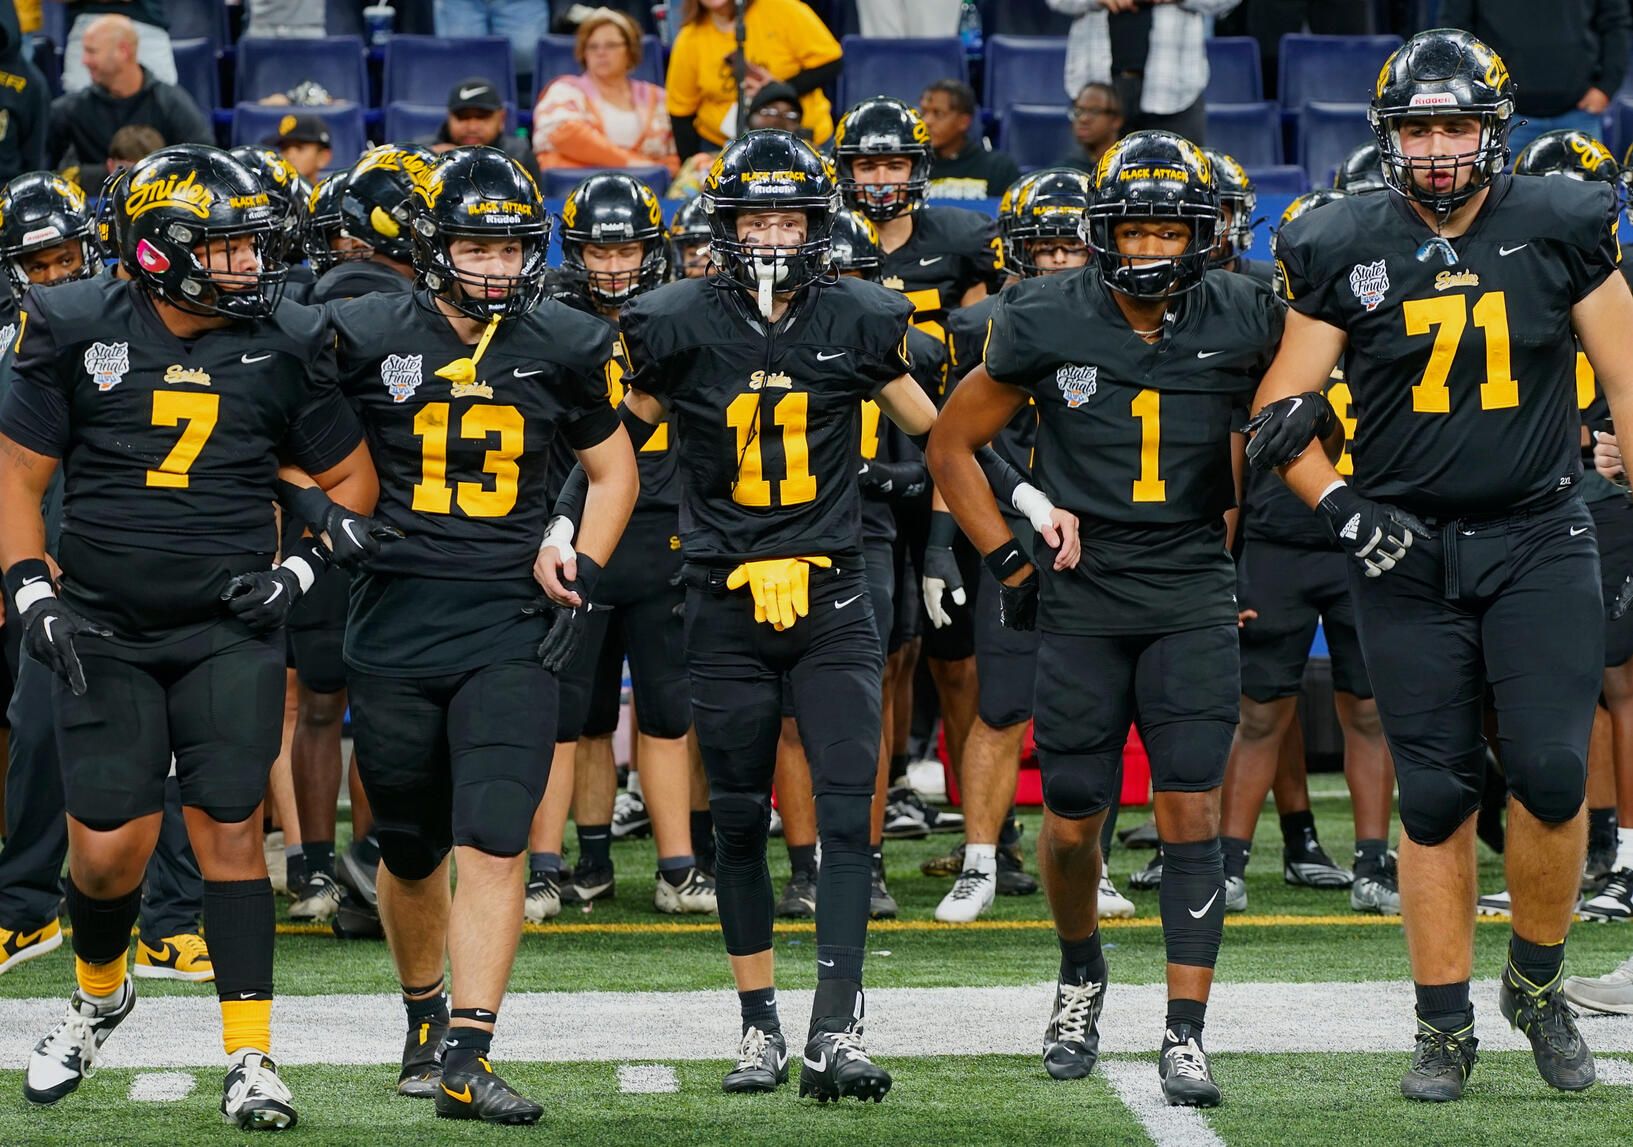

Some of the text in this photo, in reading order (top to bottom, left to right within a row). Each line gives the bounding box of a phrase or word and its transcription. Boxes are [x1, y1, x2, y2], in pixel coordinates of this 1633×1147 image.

[741, 170, 806, 183] BLACK ATTACK
[1120, 168, 1189, 183] BLACK ATTACK
[126, 169, 212, 222] Snider
[229, 196, 255, 208] BLACK
[468, 202, 532, 216] BLACK ATTACK
[1350, 262, 1386, 280] State
[1351, 275, 1389, 297] Finals
[87, 343, 127, 360] State
[1403, 290, 1520, 414] 71
[86, 358, 128, 375] Finals
[382, 356, 421, 372] State
[1058, 363, 1096, 380] State
[383, 370, 421, 388] Finals
[1058, 376, 1095, 395] Finals
[146, 390, 219, 488] 7
[1131, 389, 1166, 502] 1
[726, 391, 817, 507] 11
[411, 402, 524, 517] 13
